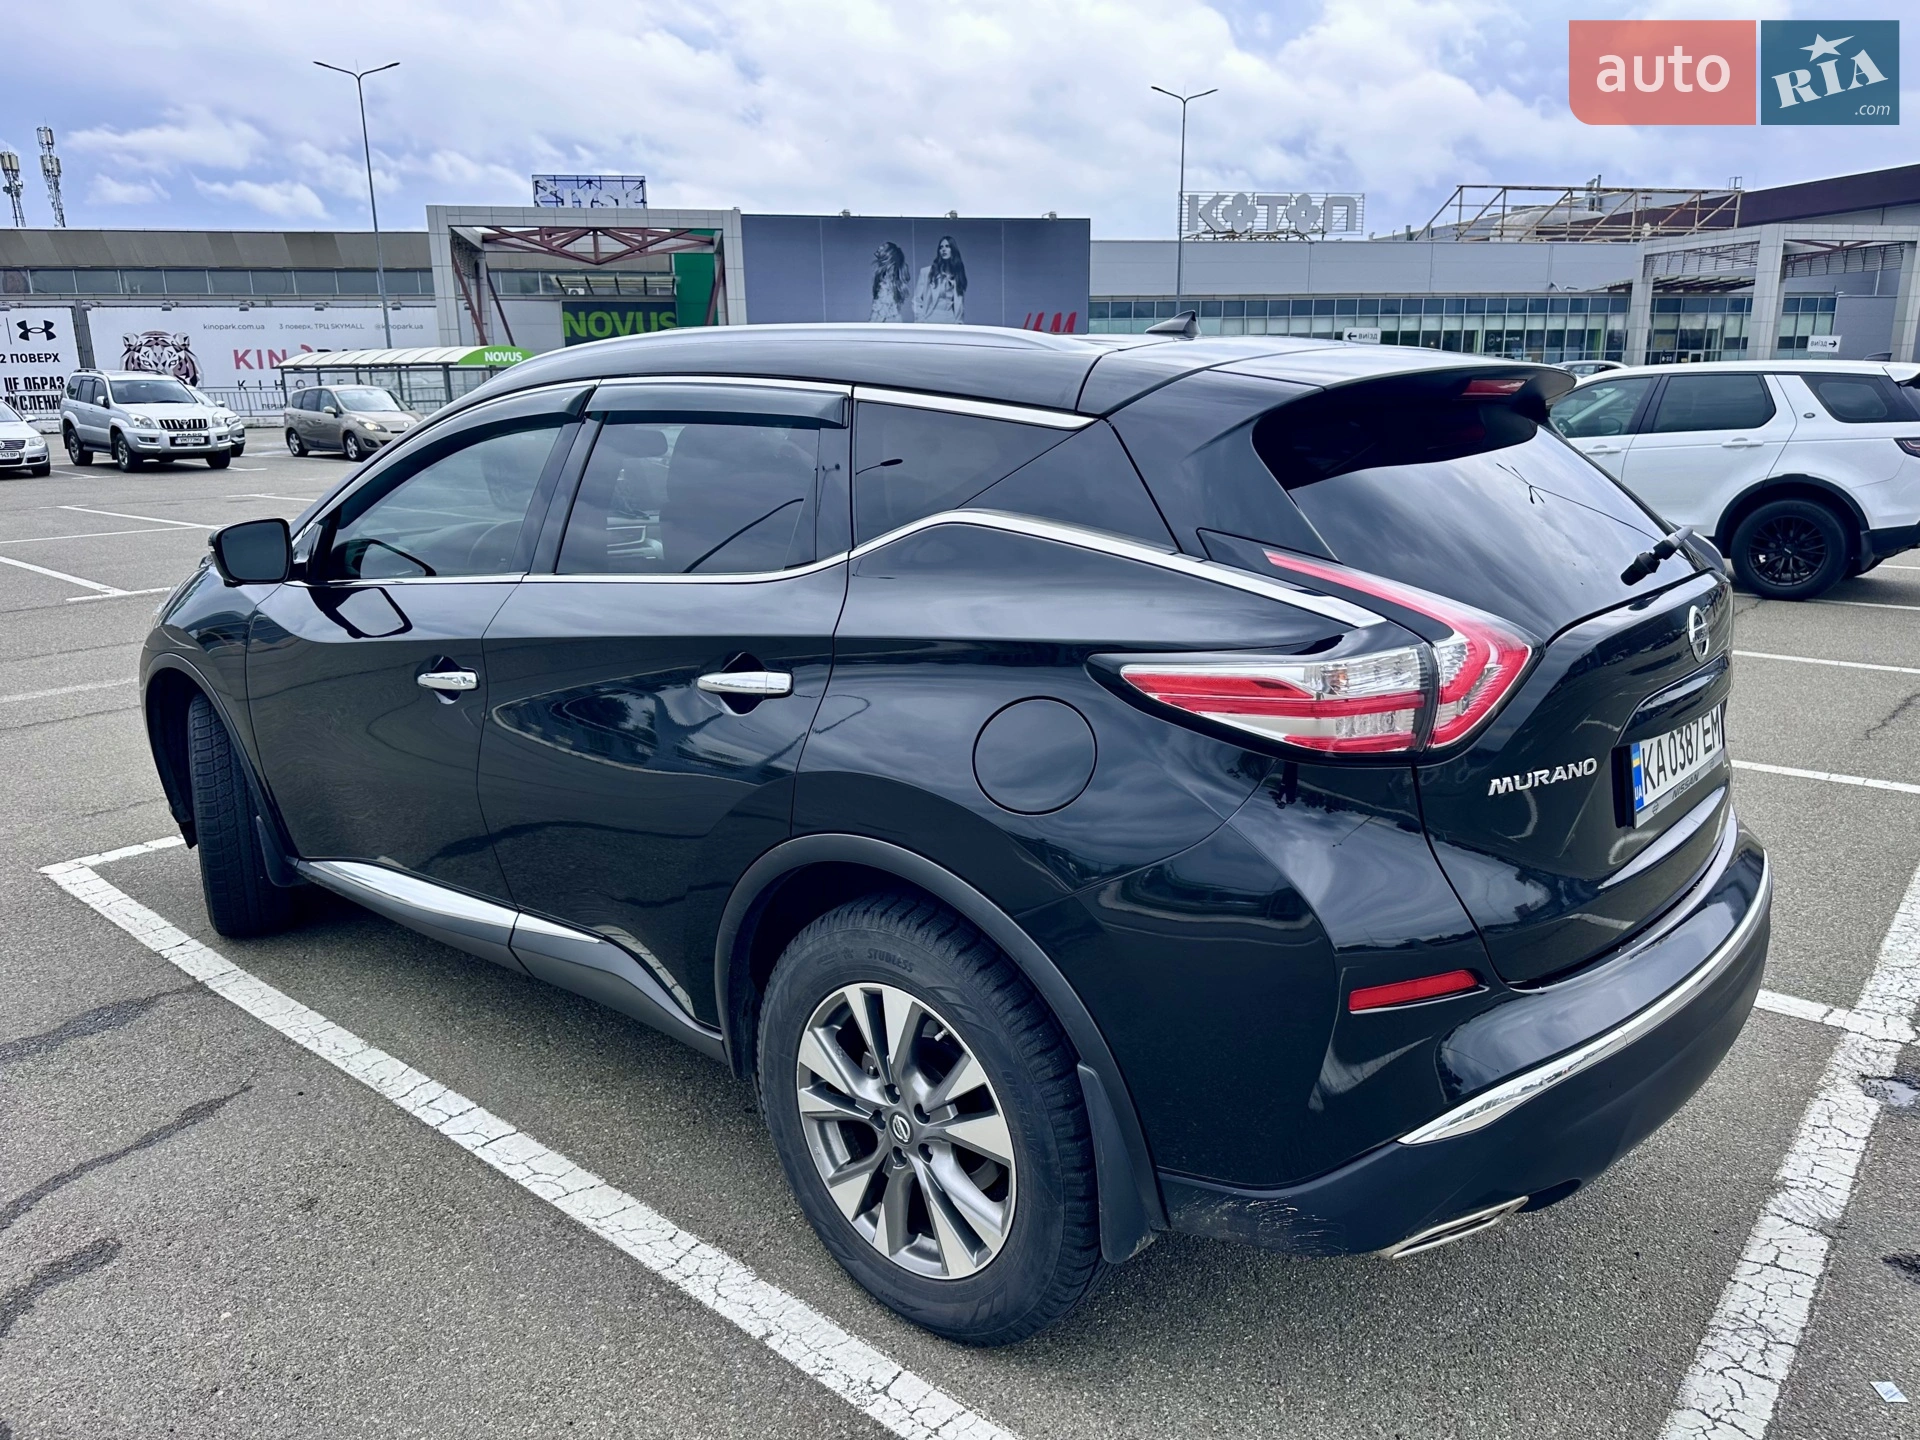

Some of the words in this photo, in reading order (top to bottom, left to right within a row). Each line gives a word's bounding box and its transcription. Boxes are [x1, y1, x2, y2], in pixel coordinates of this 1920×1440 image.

[203, 323, 265, 331] kinopark.com.ua
[563, 311, 676, 338] NOVUS
[0, 354, 6, 363] 2
[10, 353, 60, 363] ПОВЕРХ
[484, 351, 523, 362] NOVUS
[23, 376, 65, 391] ОБРАЗ
[1642, 738, 1667, 794] KA
[1668, 718, 1699, 776] 0387
[1702, 706, 1721, 755] EM
[1488, 757, 1597, 796] MURANO
[1634, 784, 1643, 801] UA
